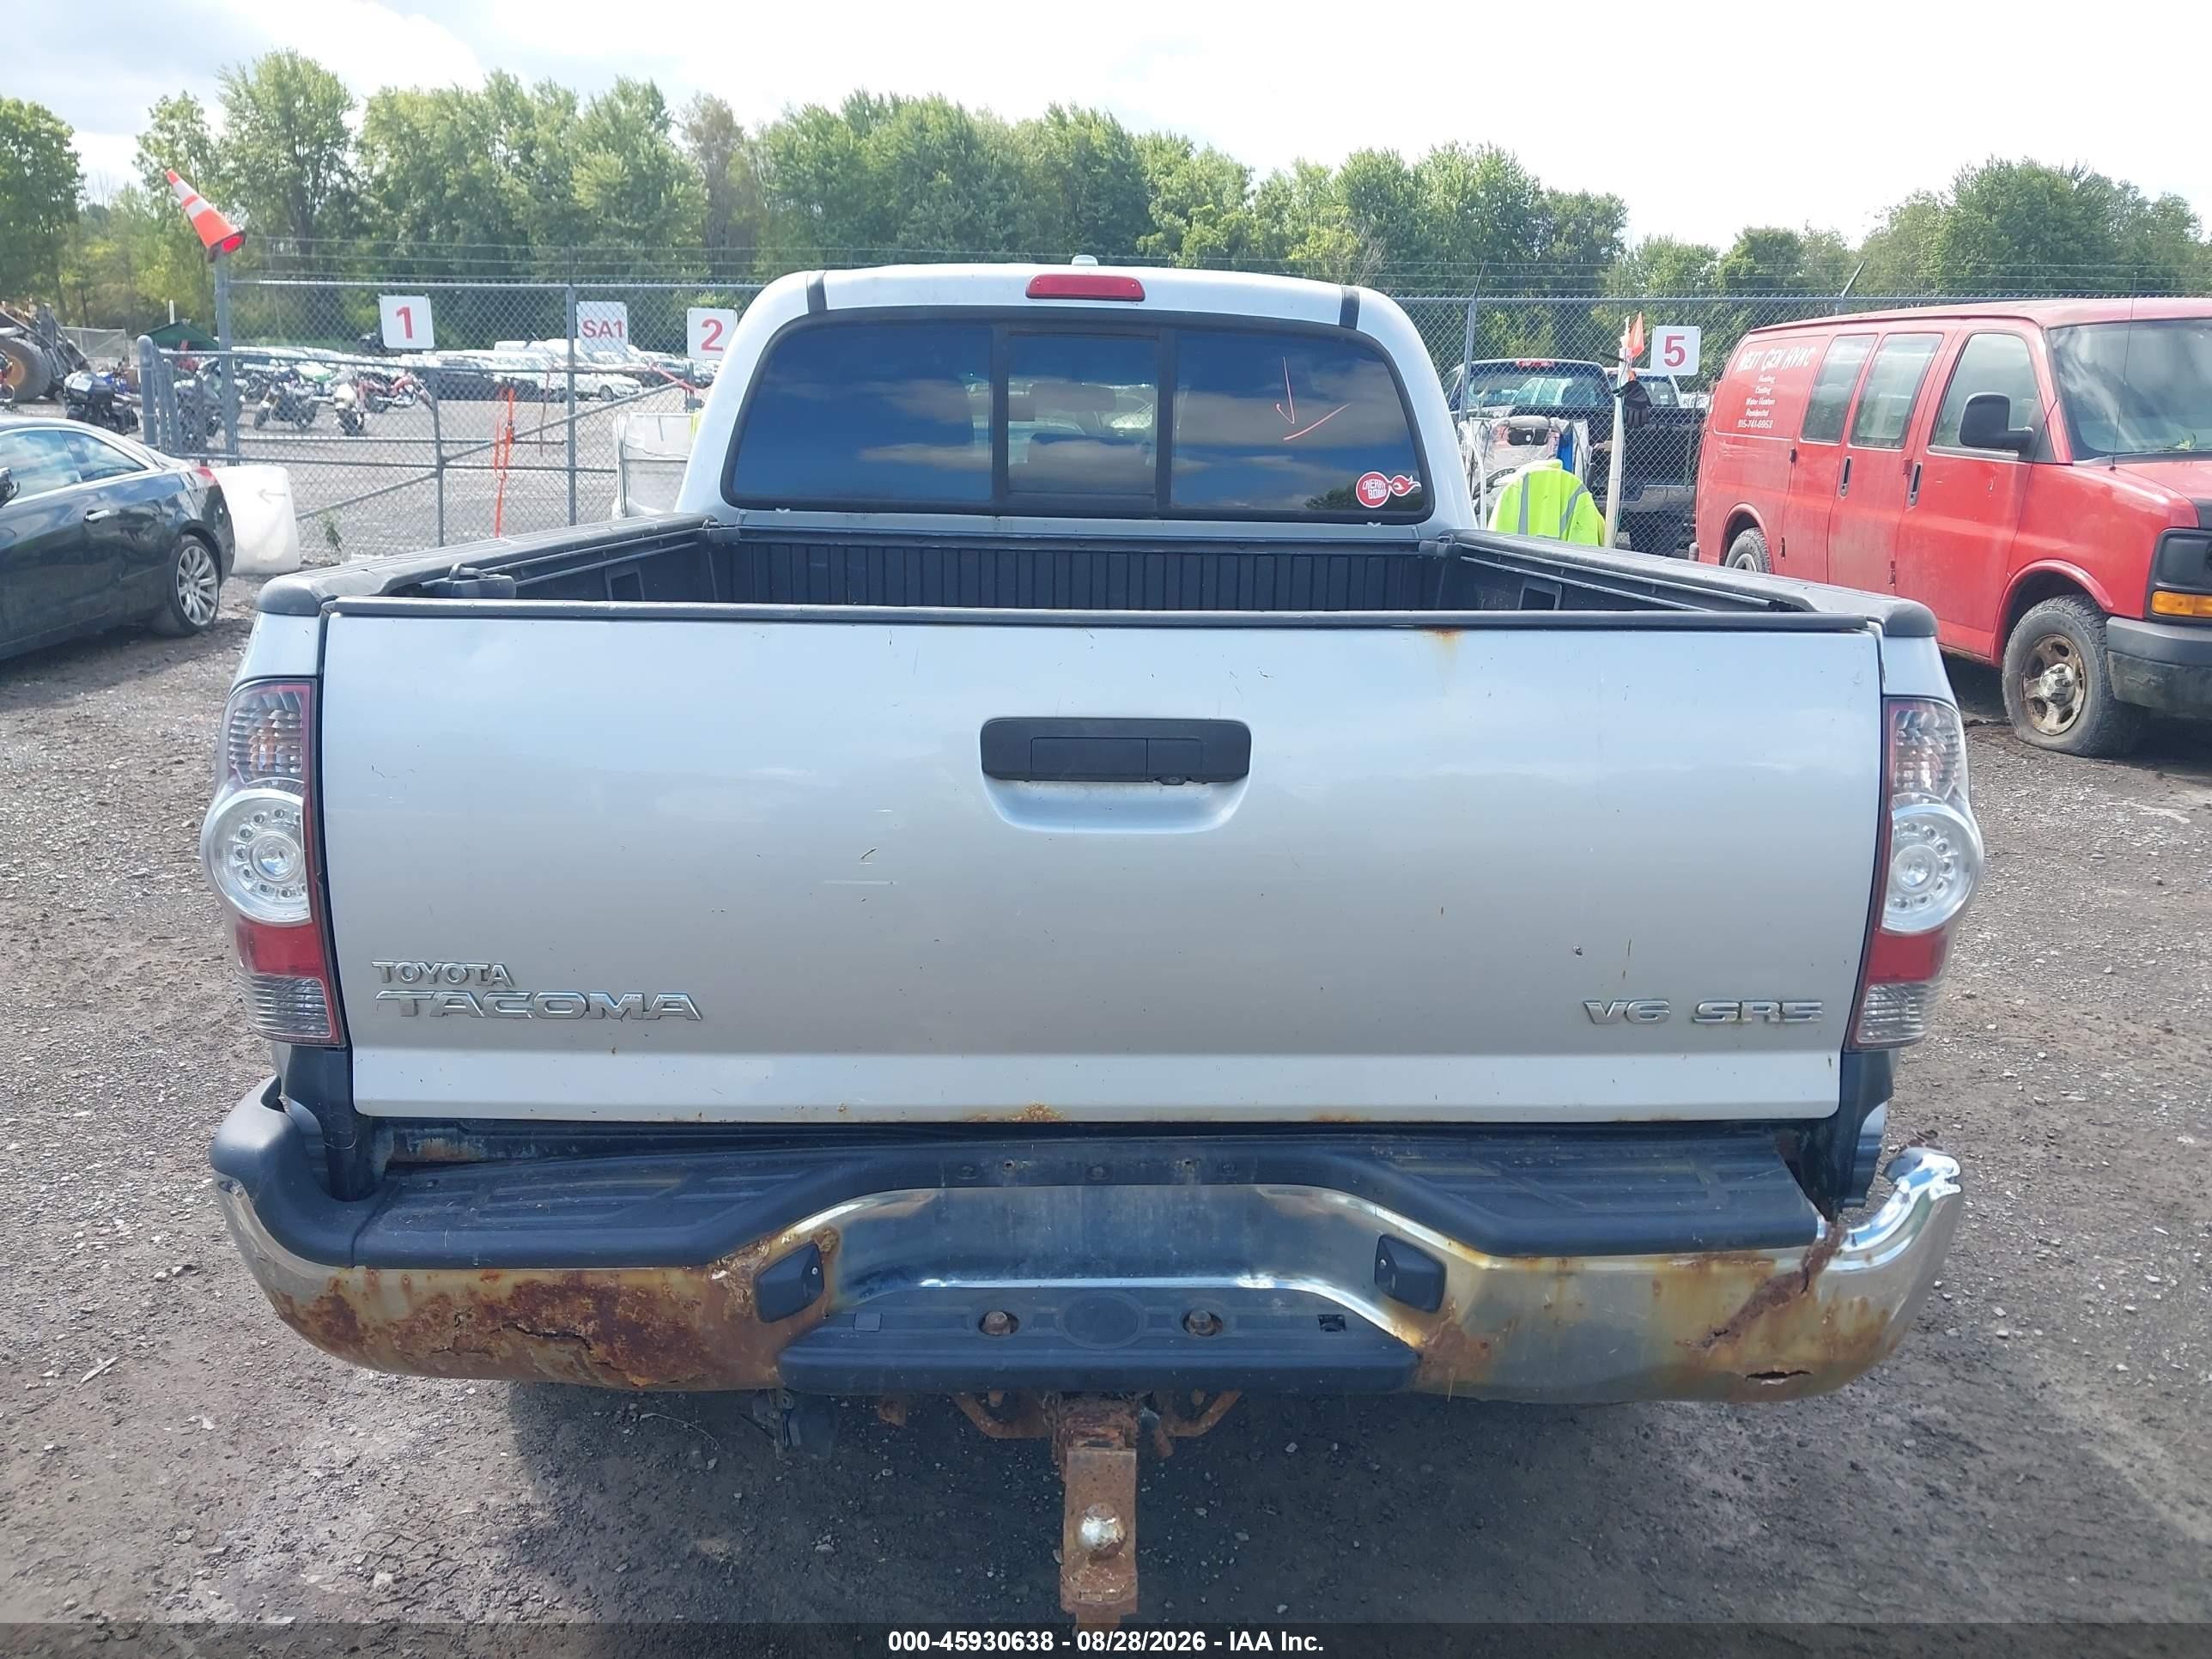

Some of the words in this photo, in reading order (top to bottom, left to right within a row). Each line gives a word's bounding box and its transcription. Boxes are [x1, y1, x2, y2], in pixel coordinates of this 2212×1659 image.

[396, 306, 414, 339] 1
[581, 319, 624, 338] SA1
[701, 319, 724, 351] 2
[1663, 335, 1686, 368] 5
[1362, 478, 1386, 490] CHERRY
[1368, 489, 1387, 500] BOMB
[371, 960, 514, 987] TOYOTA
[375, 990, 702, 1020] TACOMA
[1583, 999, 1670, 1024] V6
[1692, 1000, 1823, 1024] SR5
